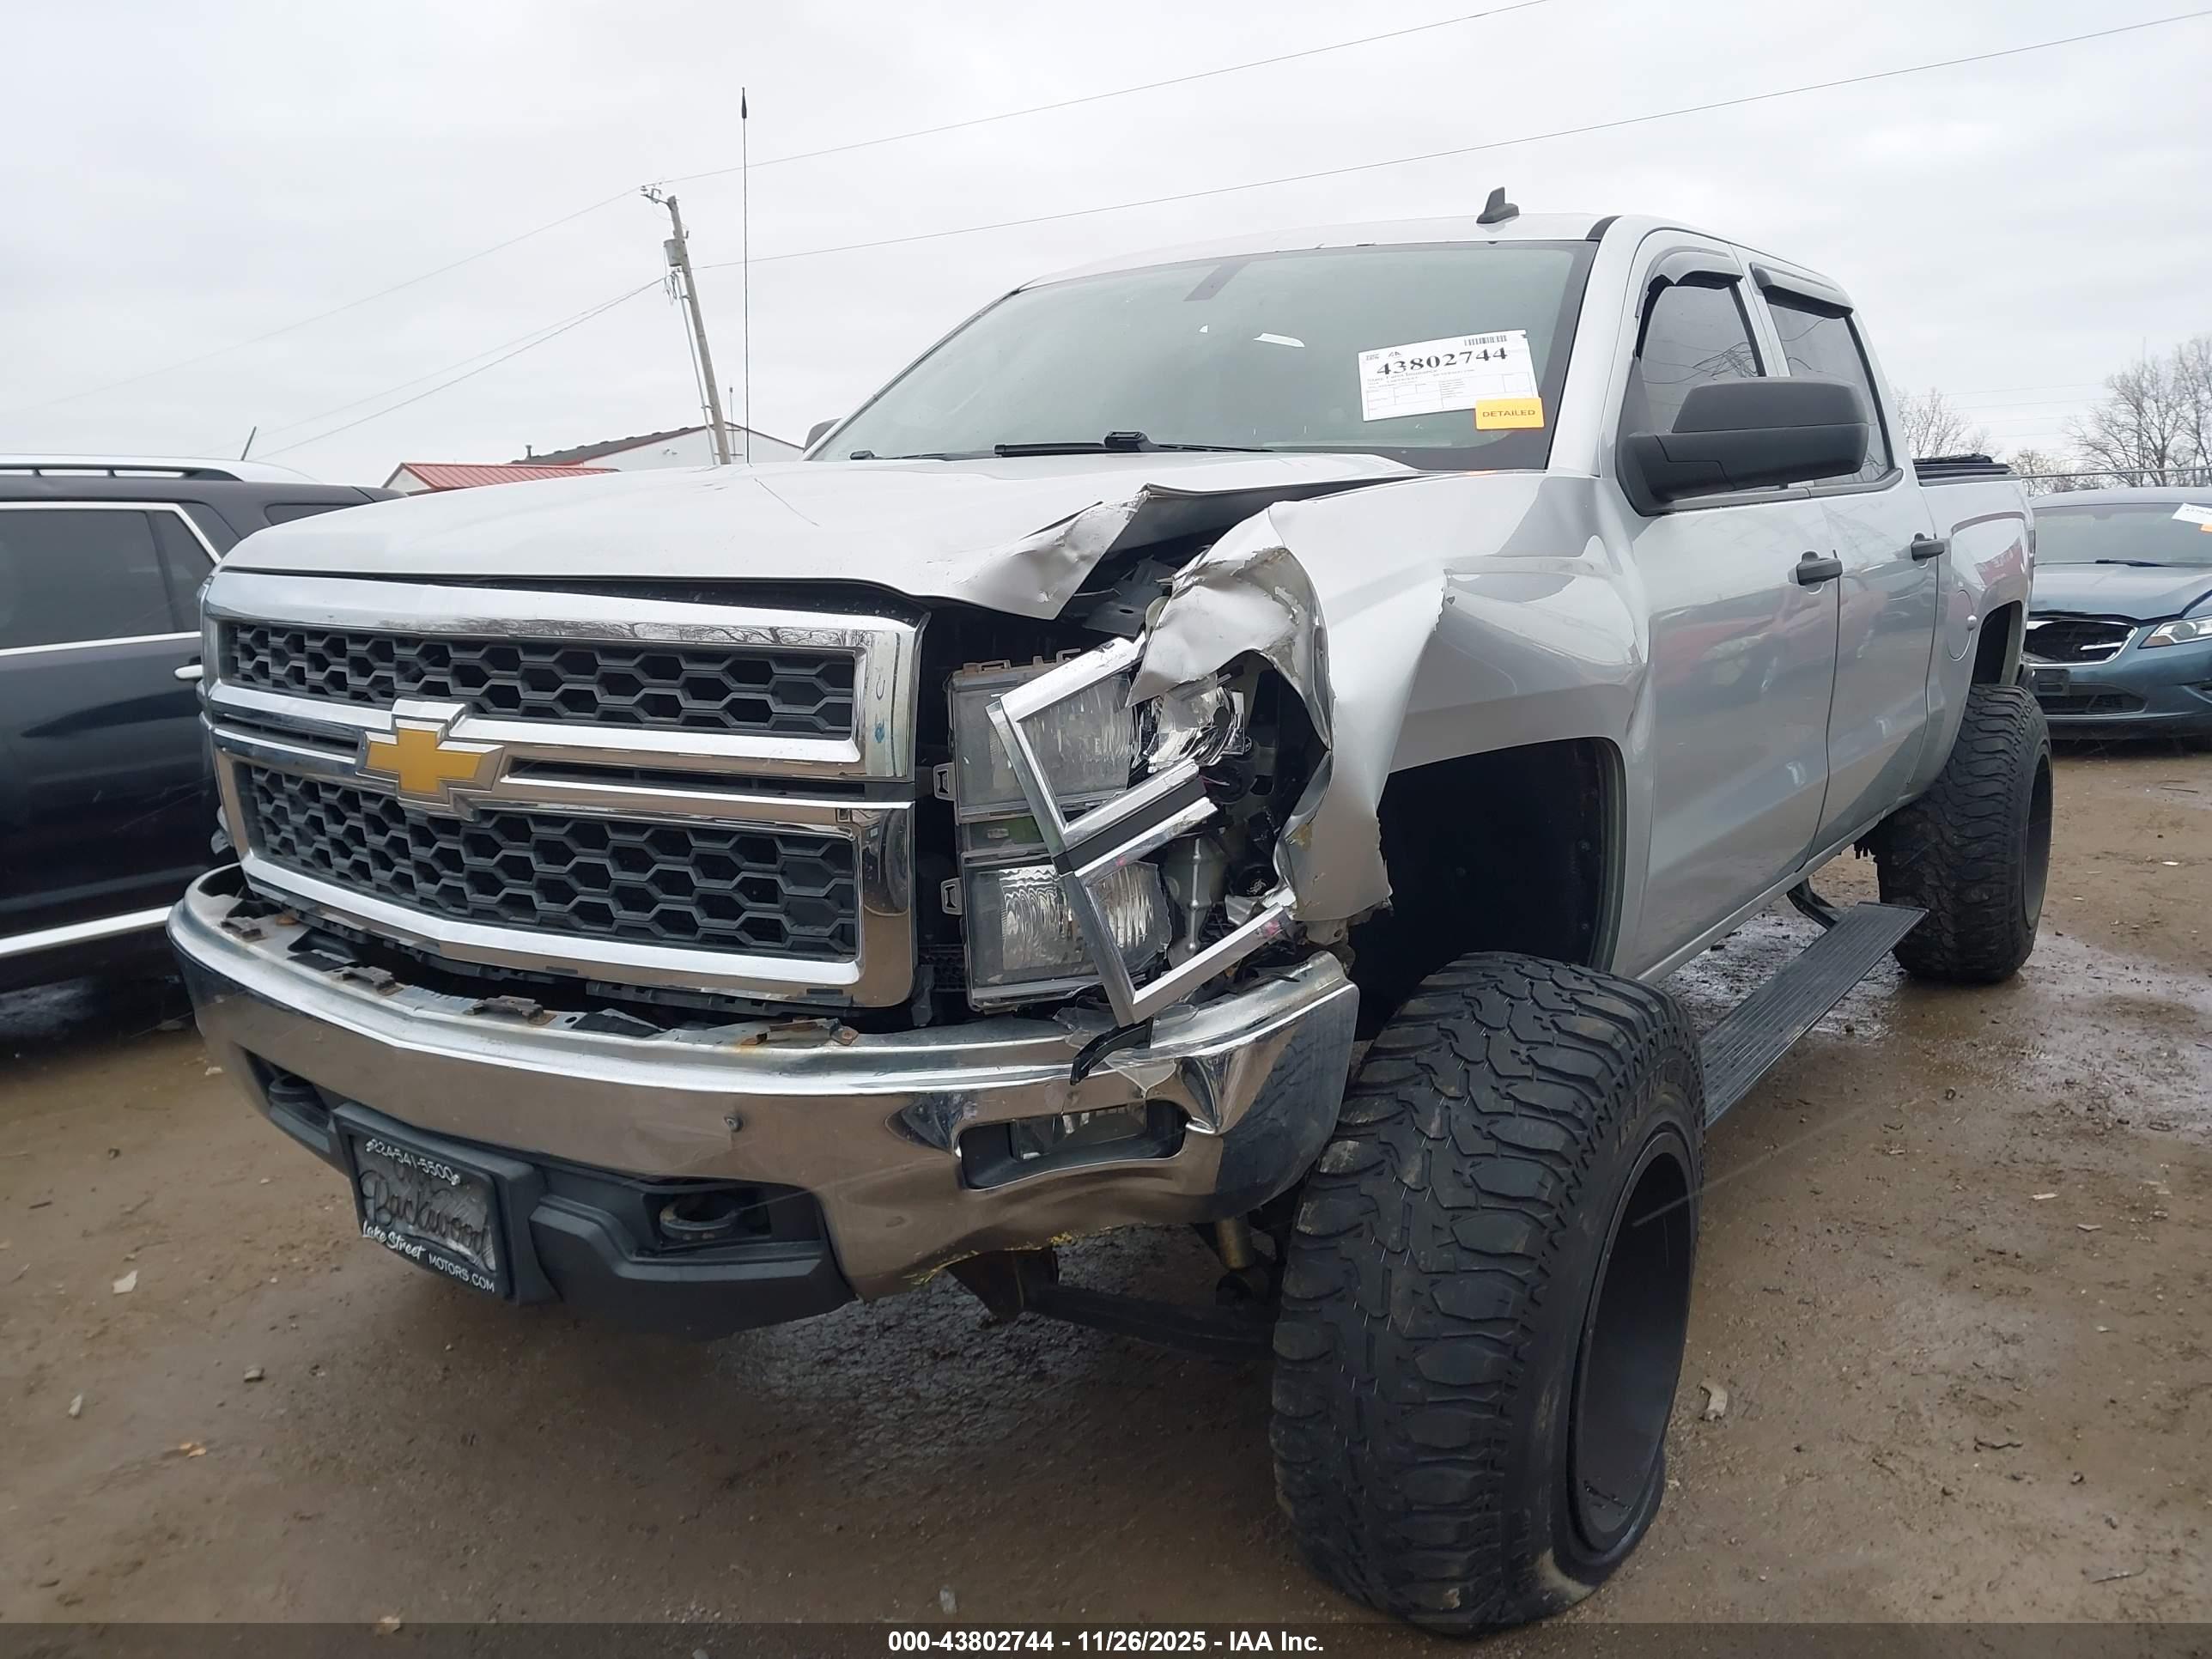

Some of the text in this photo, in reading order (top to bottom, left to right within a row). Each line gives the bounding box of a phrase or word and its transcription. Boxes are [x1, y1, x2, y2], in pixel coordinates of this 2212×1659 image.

[1376, 347, 1508, 374] 43802744
[1482, 409, 1536, 417] DETAILED
[362, 1220, 495, 1292] Lake Street MOTORS.COM
